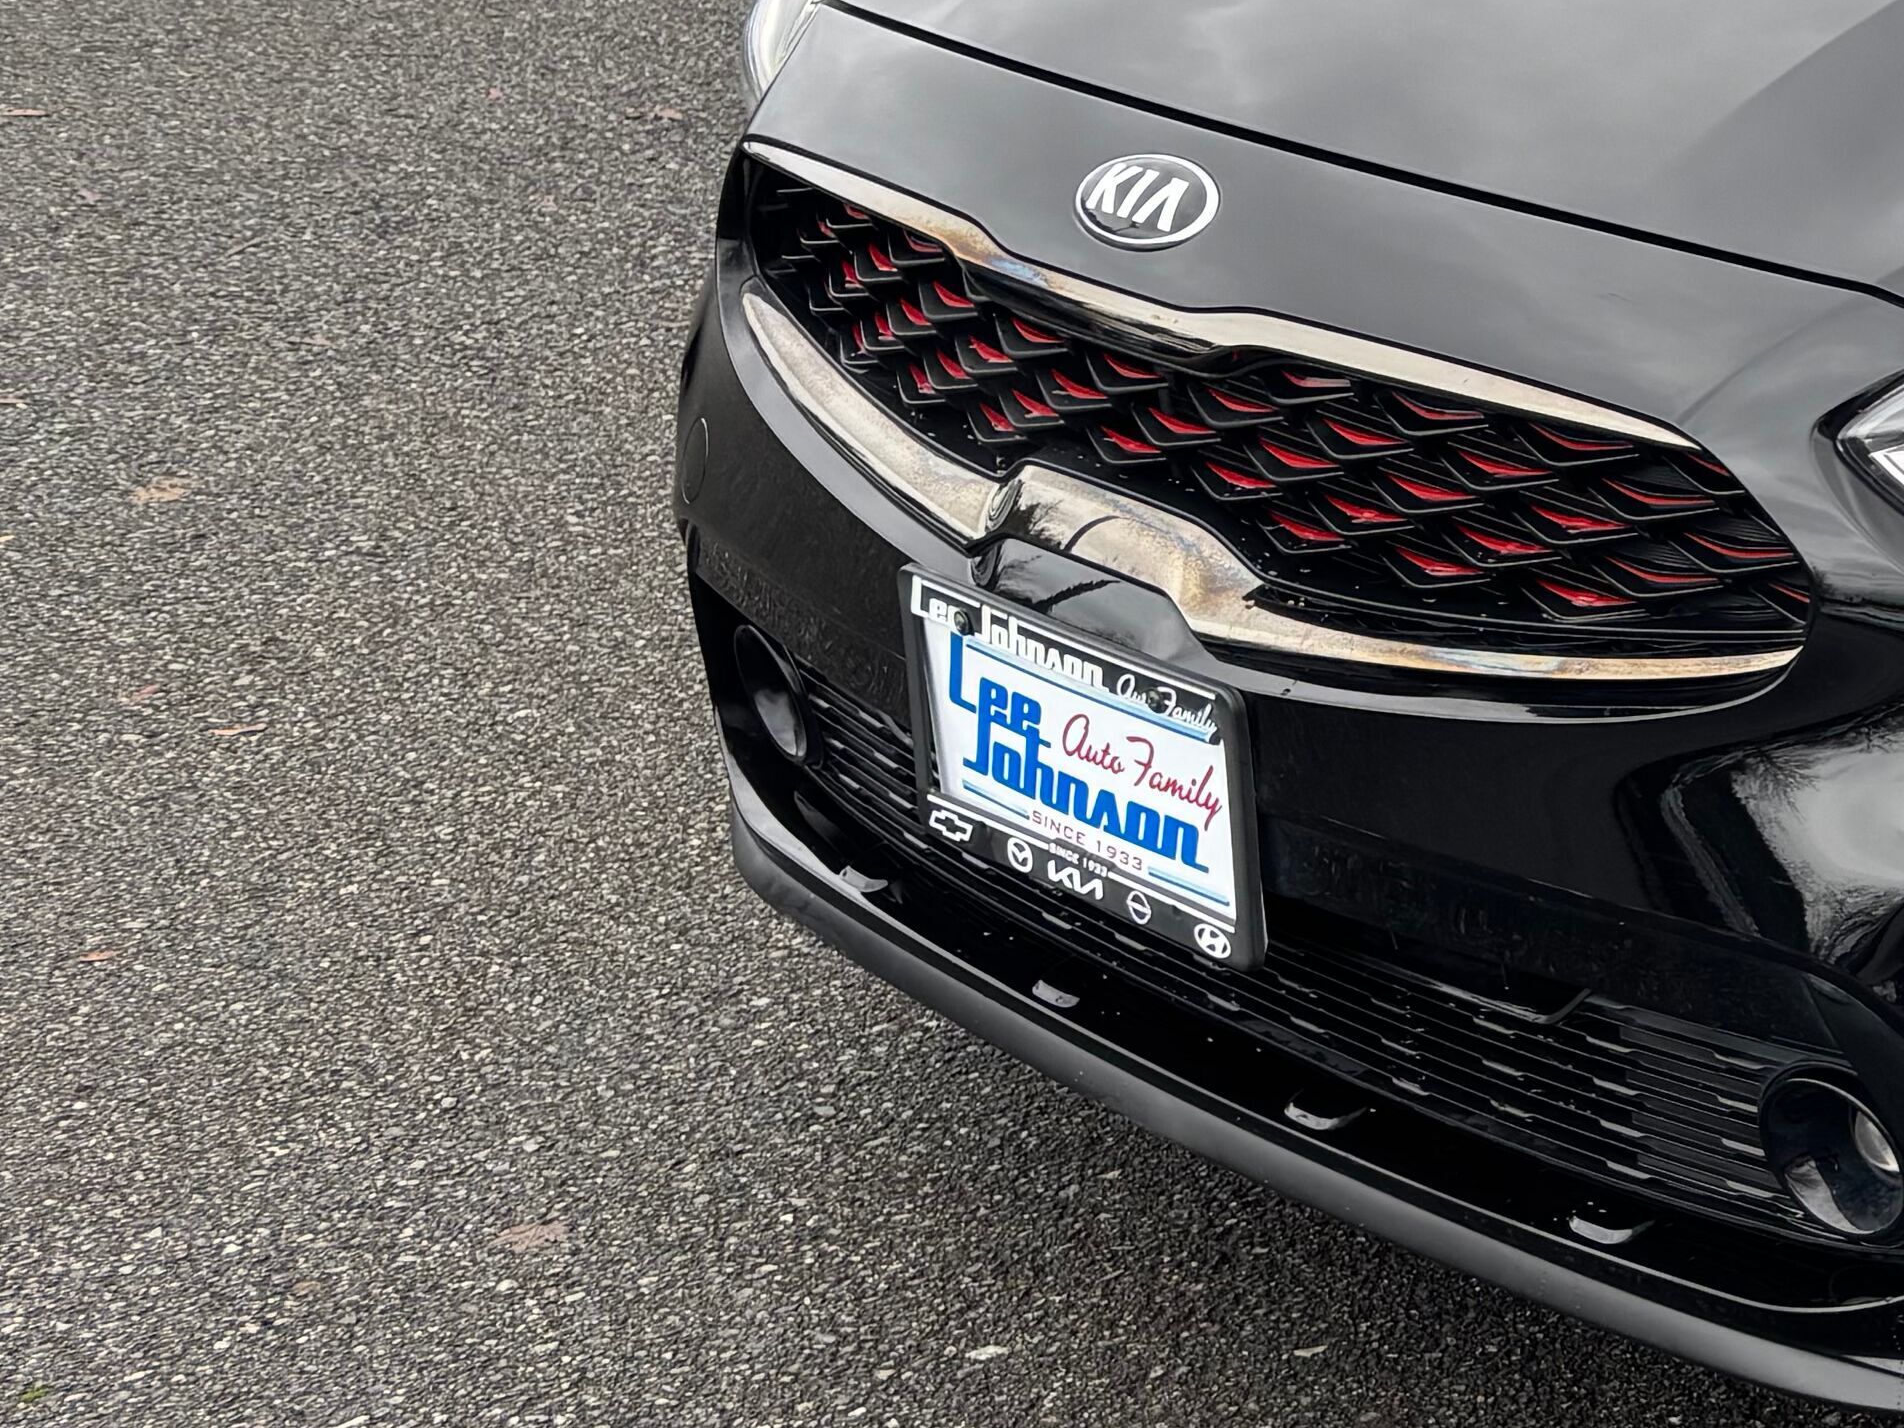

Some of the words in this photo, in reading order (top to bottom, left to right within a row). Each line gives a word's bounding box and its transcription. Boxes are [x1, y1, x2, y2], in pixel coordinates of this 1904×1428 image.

[1085, 162, 1190, 232] KIA
[974, 602, 1110, 694] Johnson
[949, 633, 1050, 746] Lee
[1062, 713, 1126, 776] Auto
[1126, 736, 1223, 831] Family
[962, 712, 1210, 873] Johnson
[1031, 810, 1087, 846] SINCE
[1096, 839, 1144, 871] 1933
